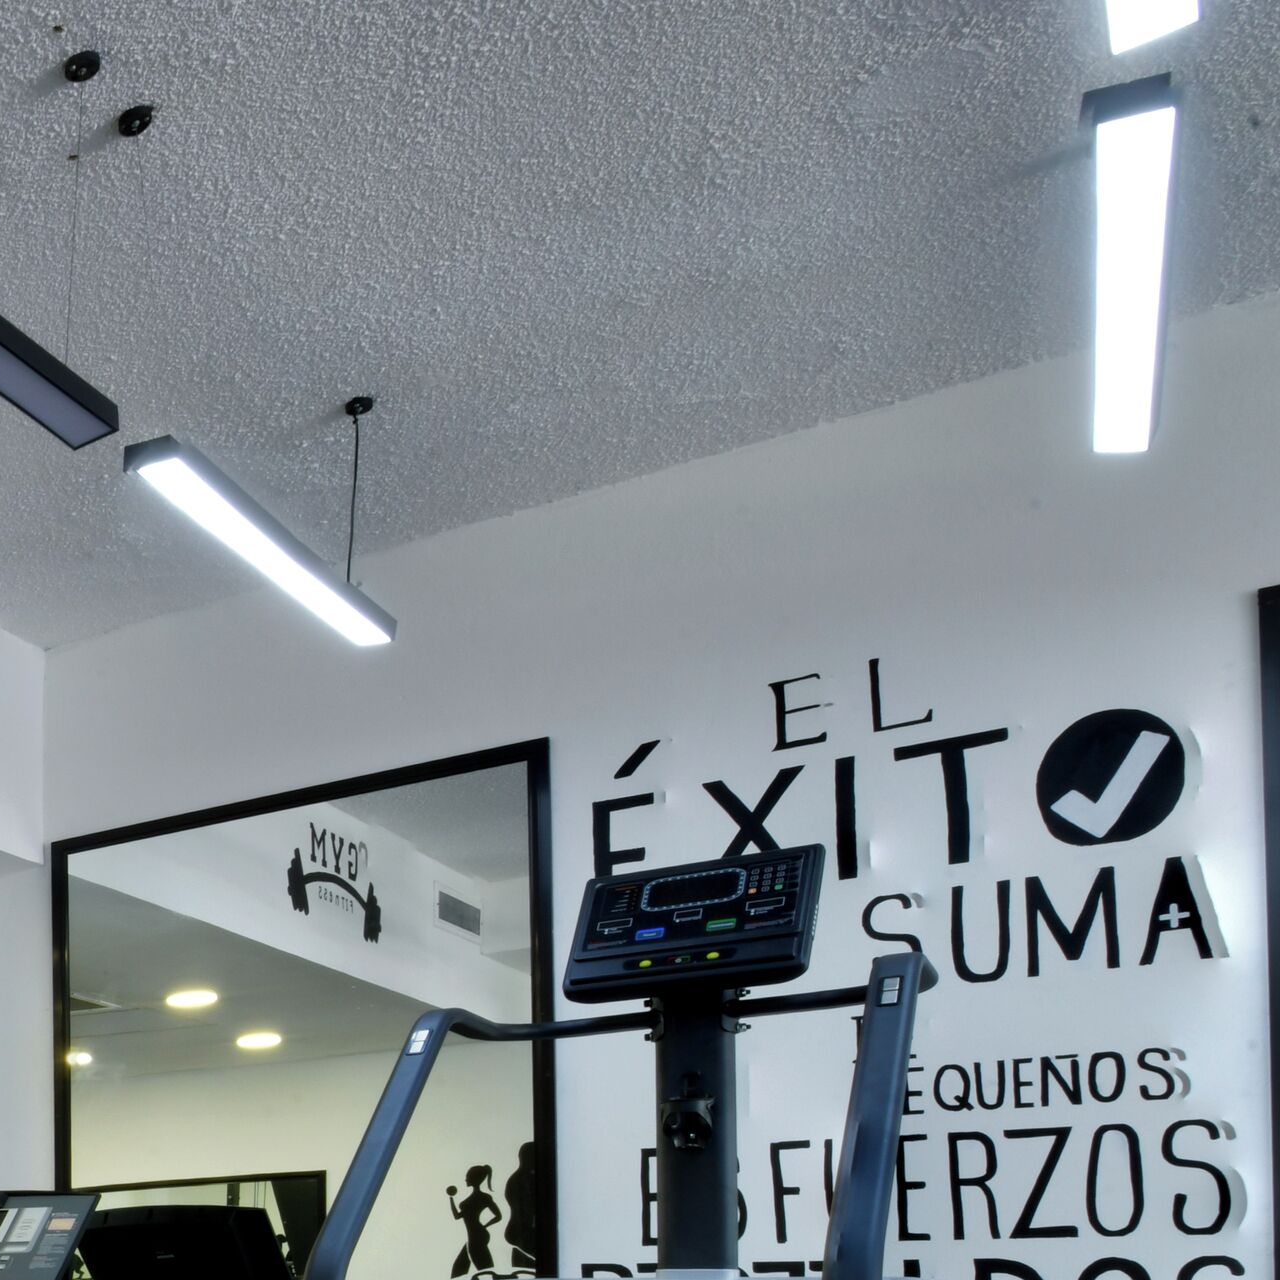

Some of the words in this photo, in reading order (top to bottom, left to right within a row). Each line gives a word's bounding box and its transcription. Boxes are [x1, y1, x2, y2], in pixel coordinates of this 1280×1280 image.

[768, 657, 933, 752] EL
[860, 855, 1214, 983] SUMA
[901, 1047, 1176, 1116] EQUEÑOS
